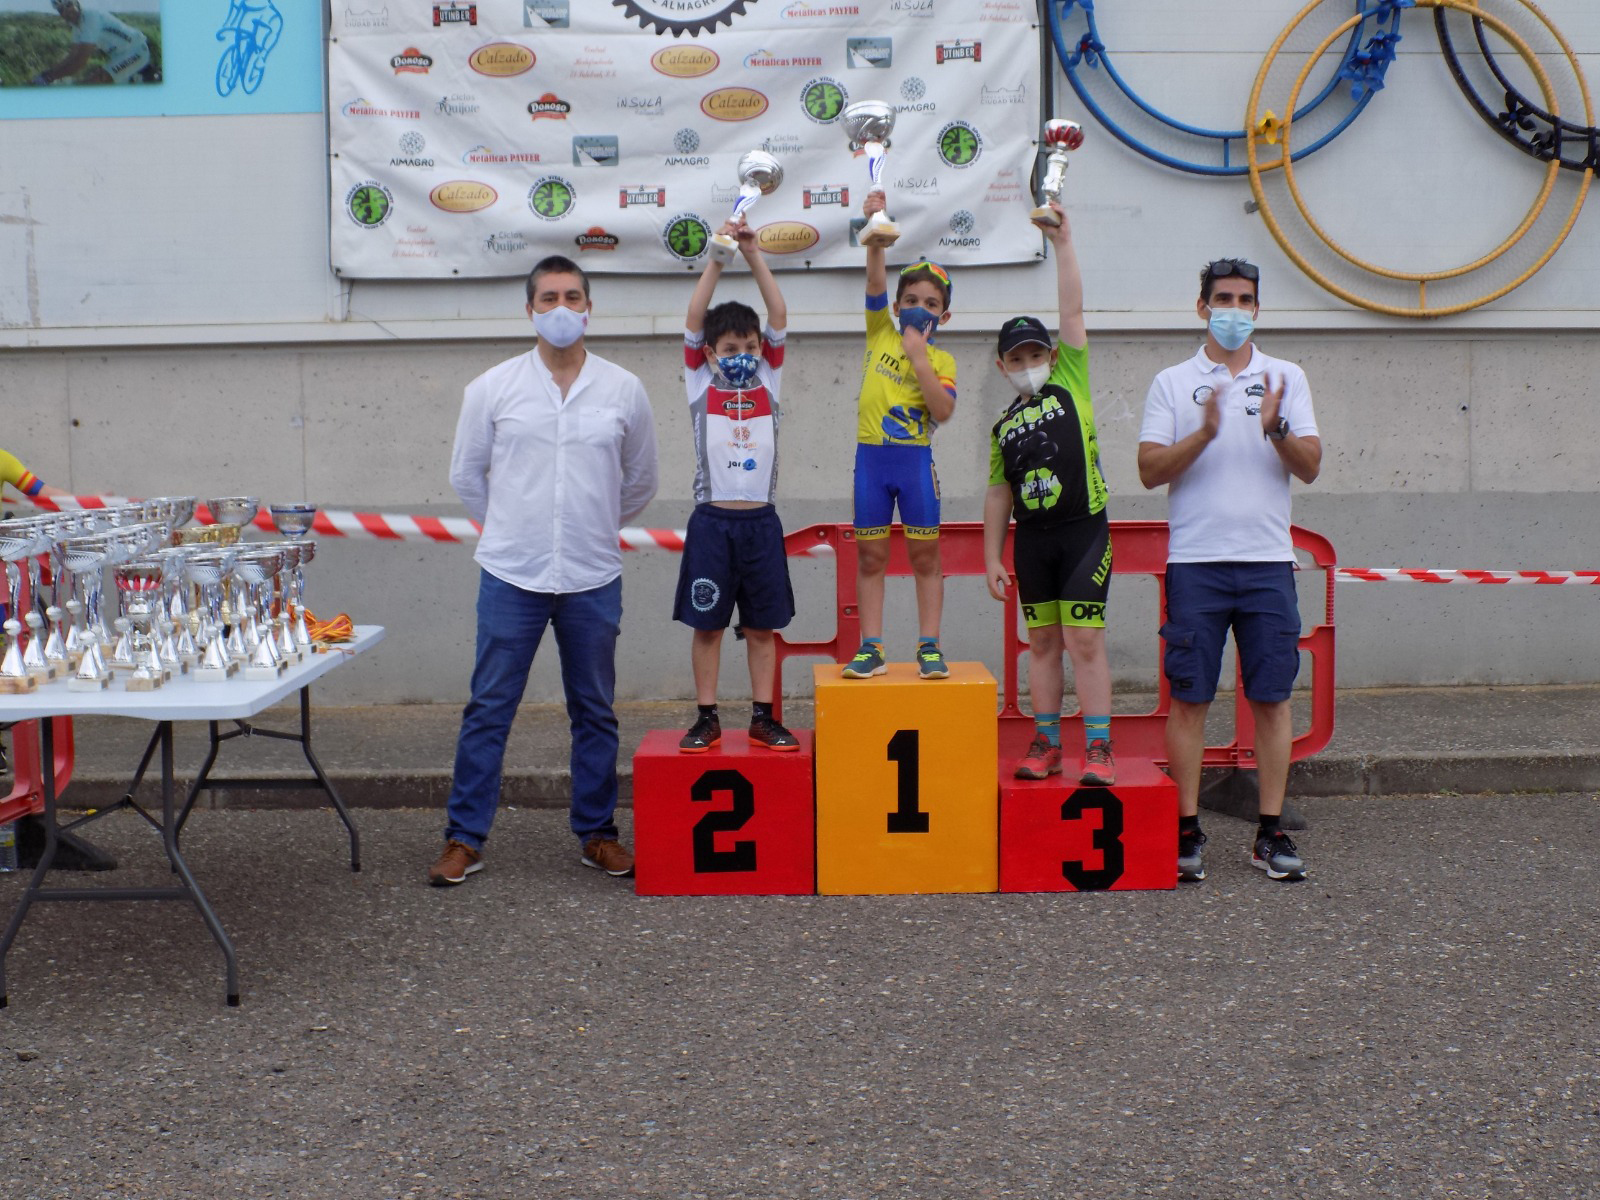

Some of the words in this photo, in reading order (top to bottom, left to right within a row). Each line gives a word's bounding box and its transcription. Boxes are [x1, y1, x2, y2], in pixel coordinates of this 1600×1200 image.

[661, 0, 717, 11] ALMAGR
[477, 50, 528, 66] Calzado
[659, 51, 711, 66] Calzado
[792, 57, 822, 66] PAYFER
[531, 102, 568, 113] Donoso
[709, 94, 760, 109] Calzado
[510, 153, 540, 163] PAYFER
[437, 187, 489, 202] Calzado
[579, 235, 615, 246] Donoso
[760, 228, 811, 244] Calzado
[907, 527, 939, 536] EKUO
[886, 729, 930, 834] 1
[690, 769, 757, 873] 2
[1060, 787, 1124, 891] 3
